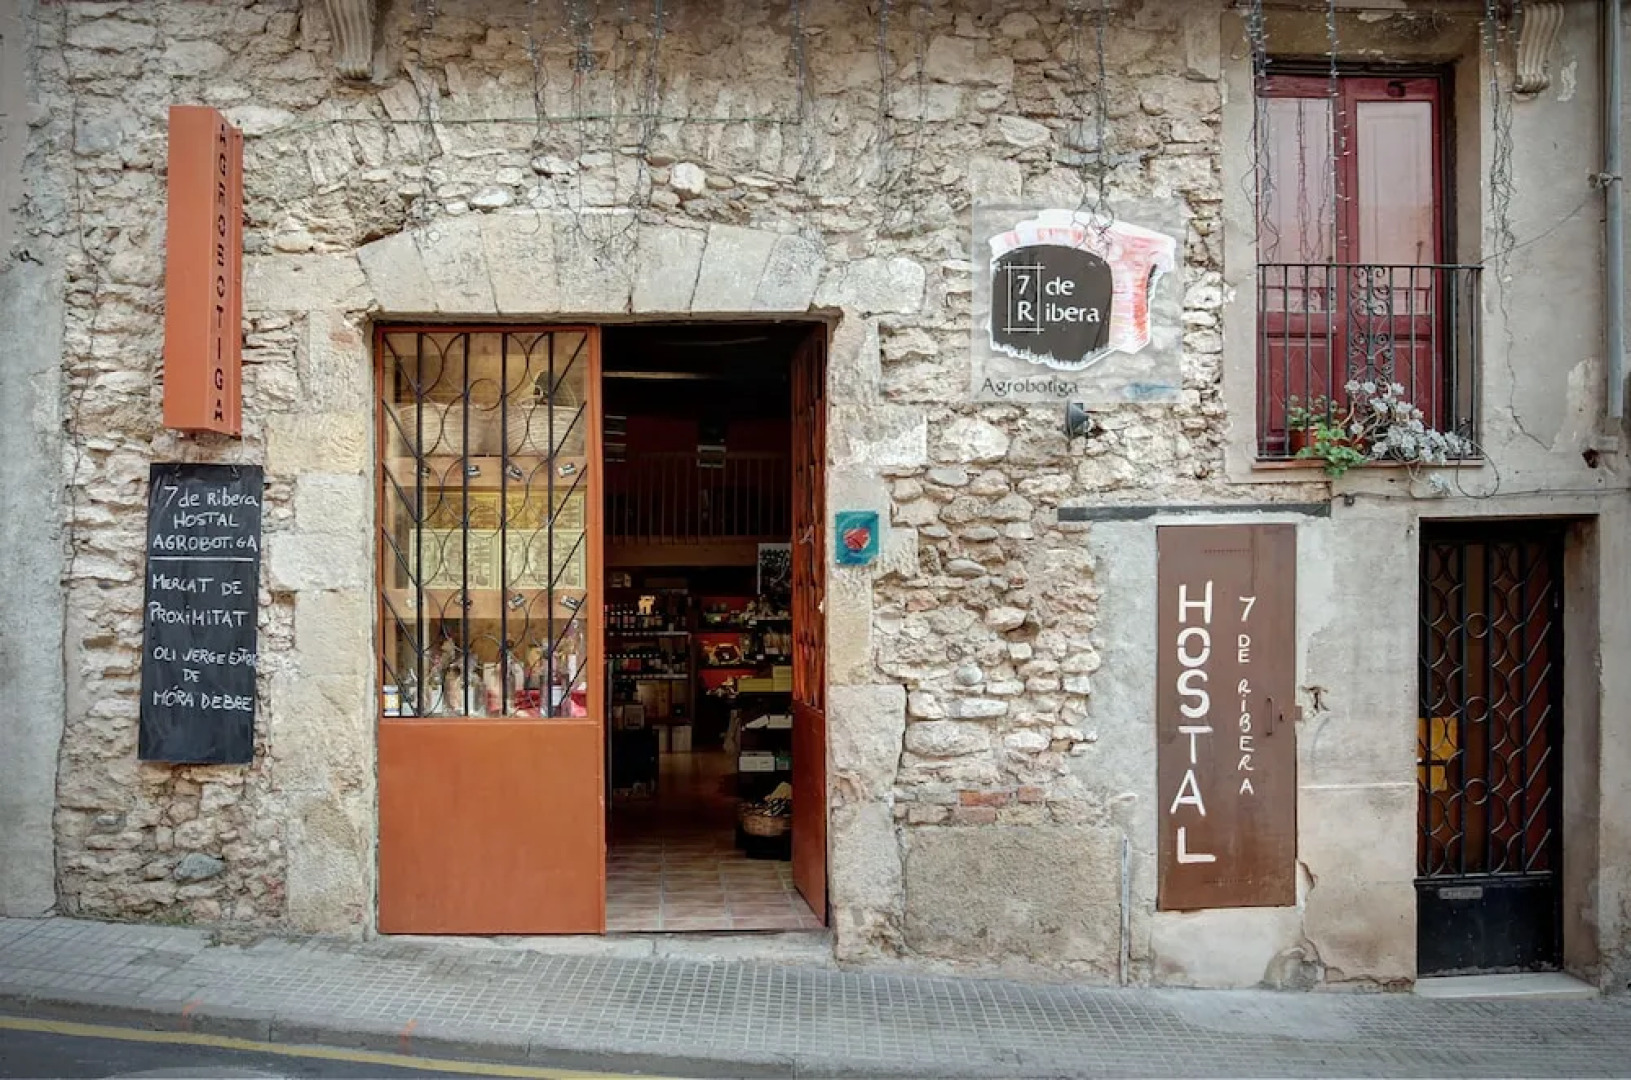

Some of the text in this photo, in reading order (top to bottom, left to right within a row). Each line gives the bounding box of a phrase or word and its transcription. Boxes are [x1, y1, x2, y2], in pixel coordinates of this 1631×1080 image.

[1017, 275, 1075, 296] 7 de
[982, 378, 1079, 396] Agrobotiga
[163, 485, 259, 508] 7 de Ribera
[173, 510, 240, 529] HOSTAL
[221, 580, 243, 596] DE
[1238, 595, 1256, 622] 7
[153, 645, 176, 662] OLI
[1237, 633, 1251, 664] DE
[183, 668, 200, 683] DE
[1170, 580, 1216, 864] HOSTAL
